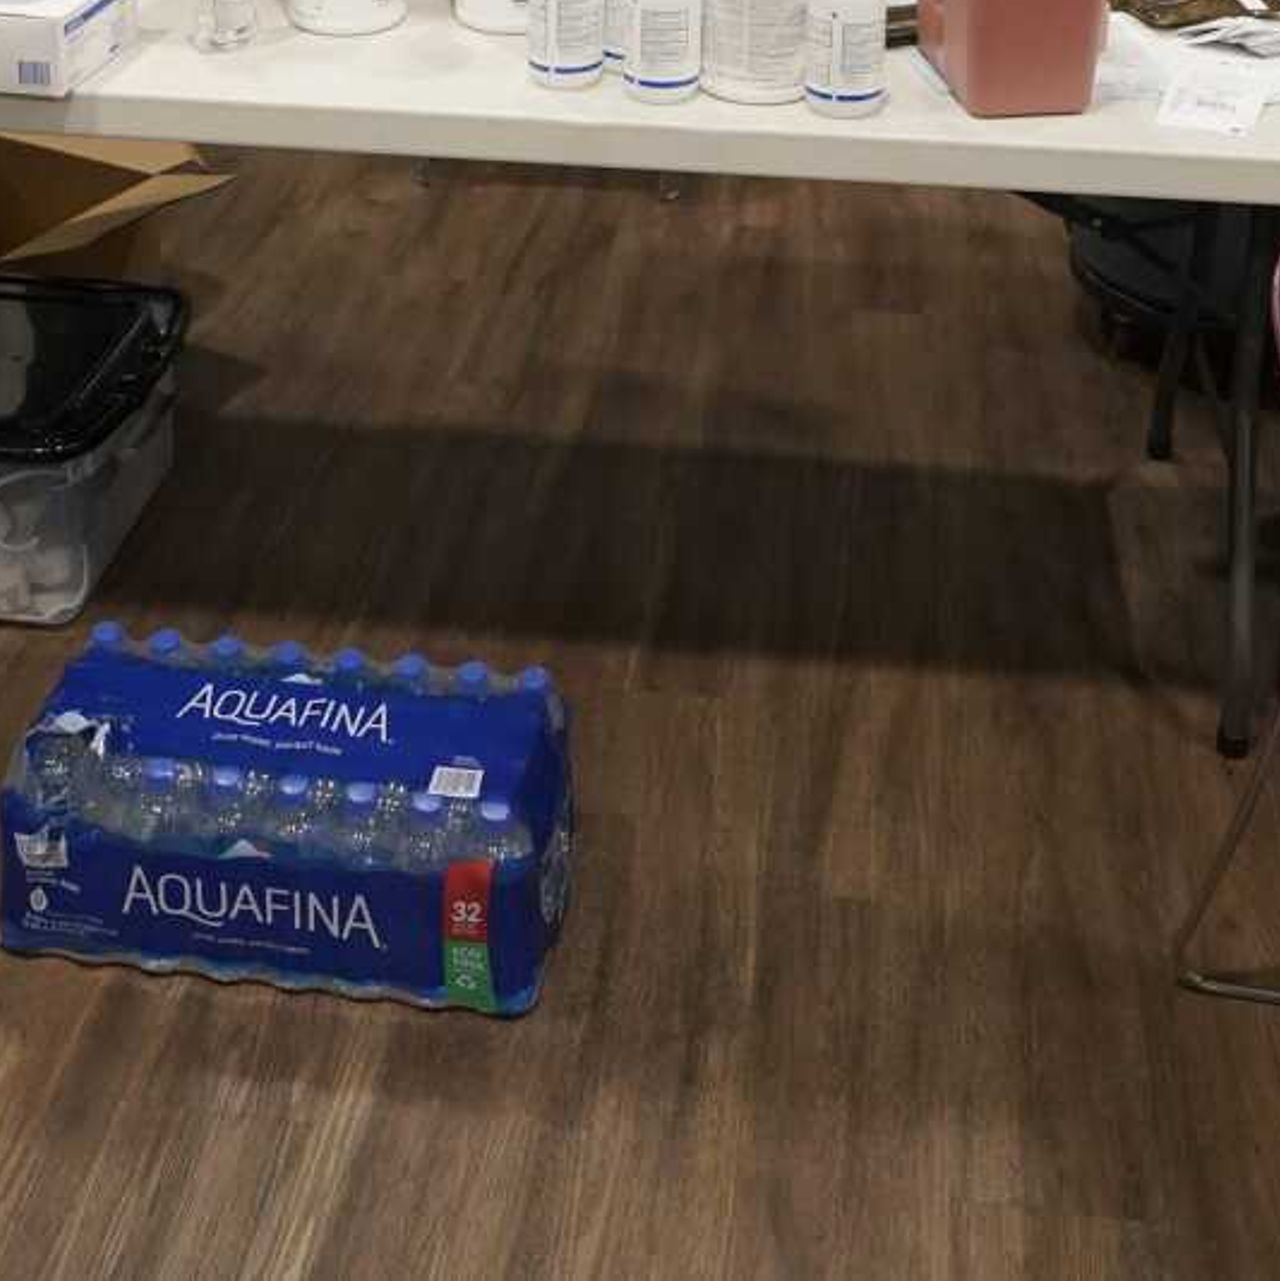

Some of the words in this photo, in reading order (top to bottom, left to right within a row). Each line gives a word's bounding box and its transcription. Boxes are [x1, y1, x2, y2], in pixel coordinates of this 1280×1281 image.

[176, 682, 388, 743] AQUAFINA
[122, 865, 381, 949] AQUAFINA
[451, 900, 484, 923] 32
